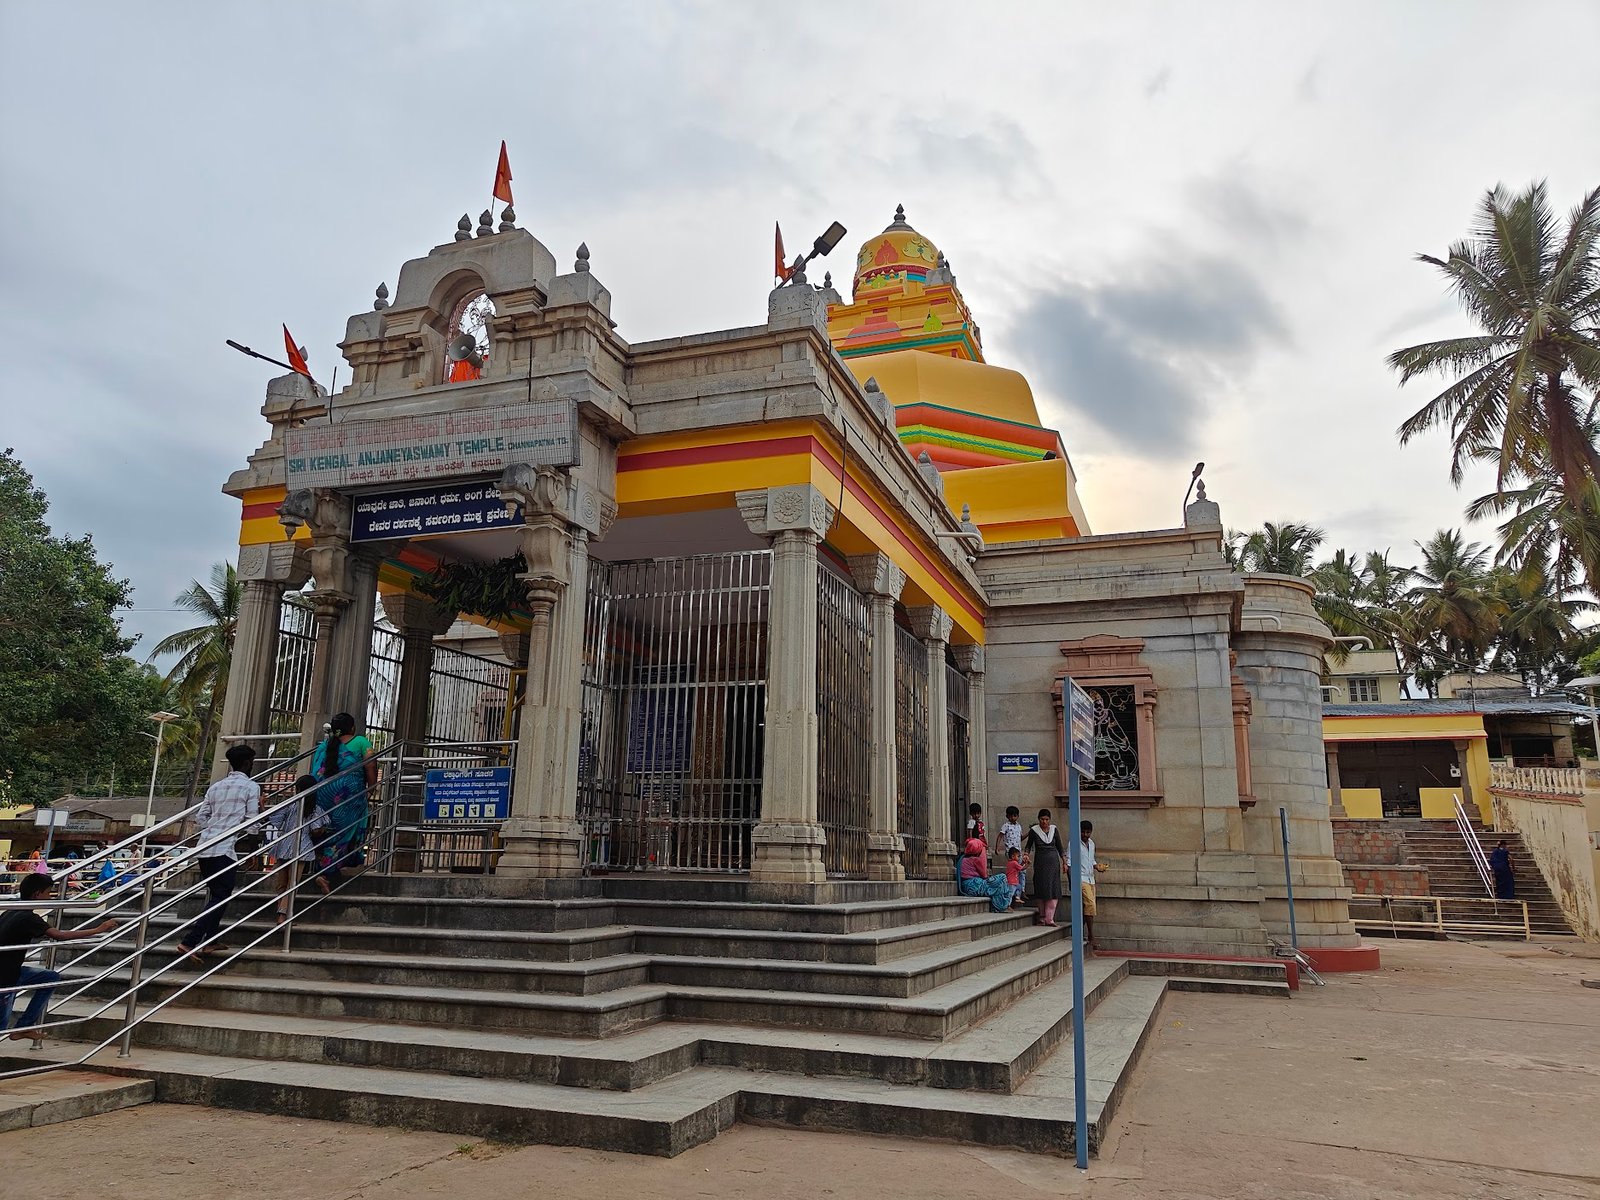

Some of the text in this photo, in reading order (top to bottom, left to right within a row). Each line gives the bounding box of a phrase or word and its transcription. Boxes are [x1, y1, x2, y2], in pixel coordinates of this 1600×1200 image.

[289, 458, 305, 473] SRI
[310, 453, 352, 471] KENGAL
[357, 442, 451, 466] ANJANEYASWAMY
[508, 438, 555, 450] CHANNAPATNA
[357, 499, 387, 513] ಯಾವುದೇ
[369, 520, 391, 532] ದೇವರ
